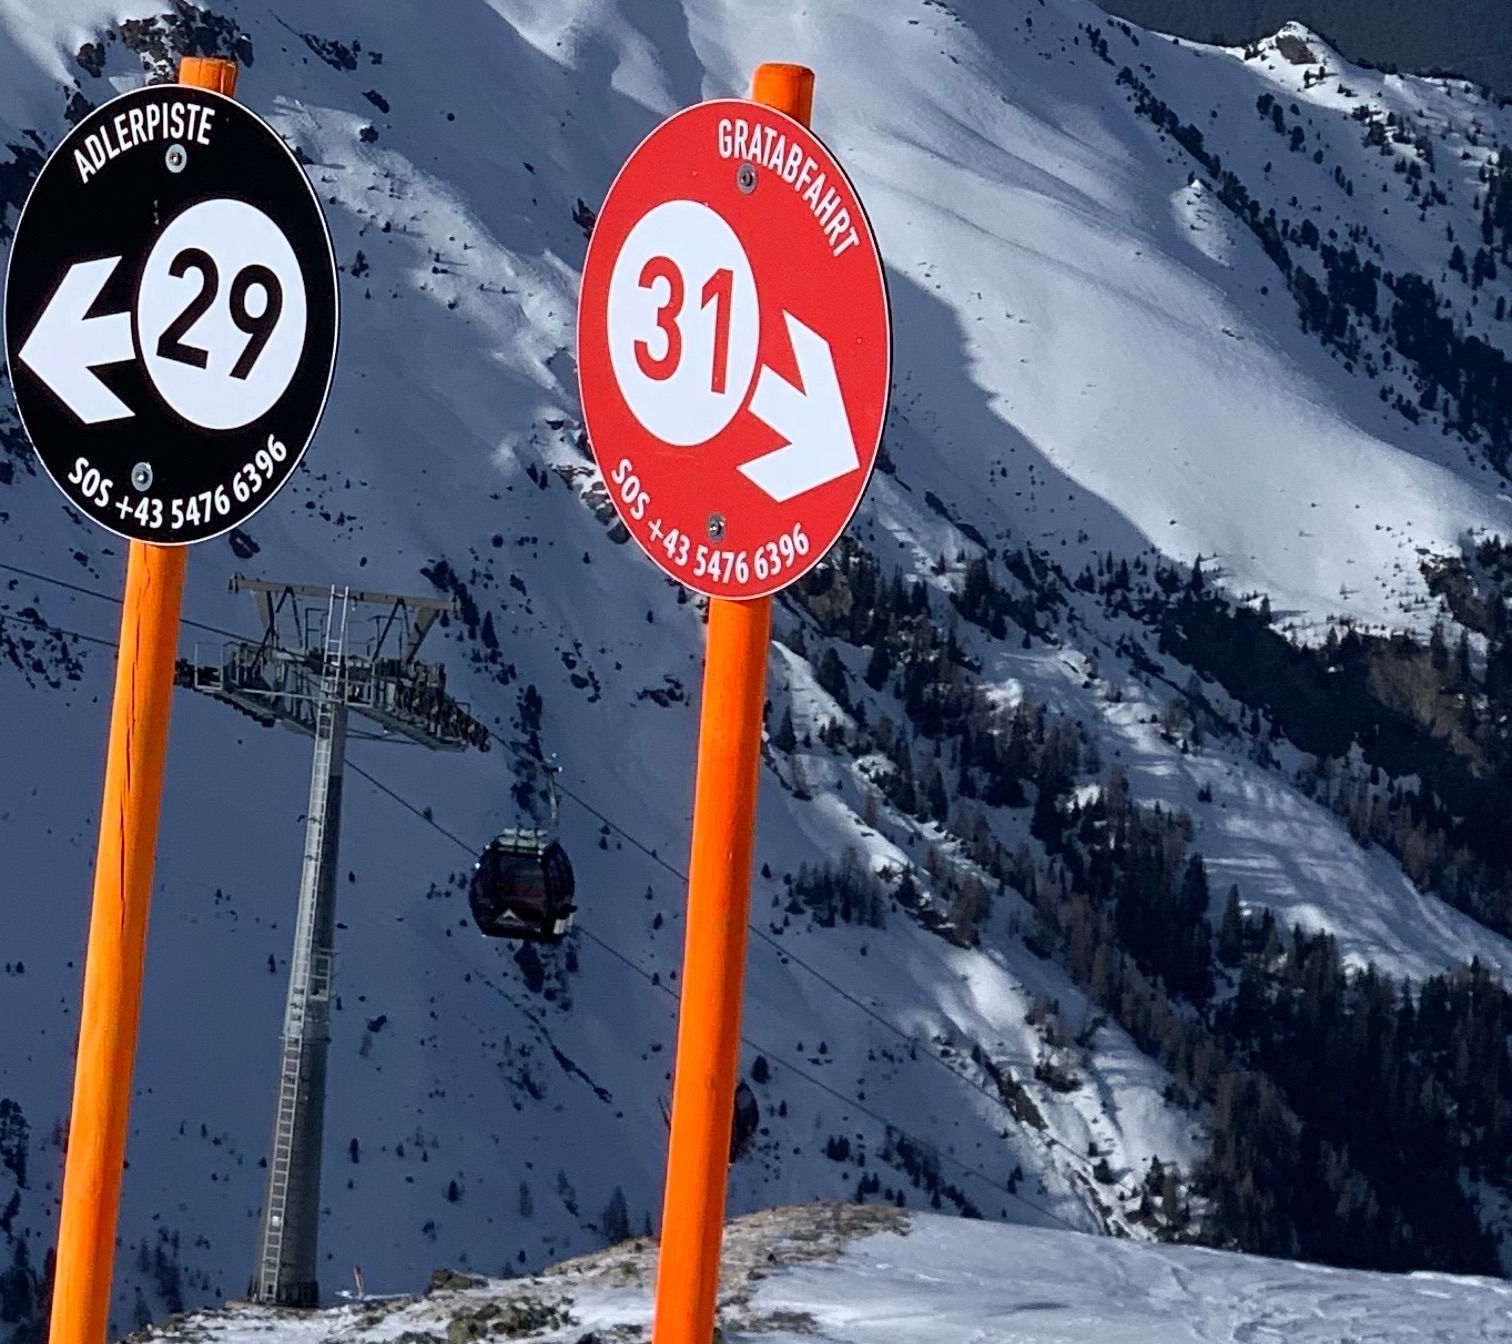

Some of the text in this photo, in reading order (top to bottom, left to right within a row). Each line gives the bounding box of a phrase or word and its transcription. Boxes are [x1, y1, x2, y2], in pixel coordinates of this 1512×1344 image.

[72, 101, 216, 184] ADLERPISTE
[718, 118, 861, 257] GRATABFAHRT
[156, 247, 283, 381] 29
[633, 255, 734, 395] 31
[68, 433, 288, 530] SOS +43 5476 6396
[611, 458, 810, 584] SOS +43 5476 6396
